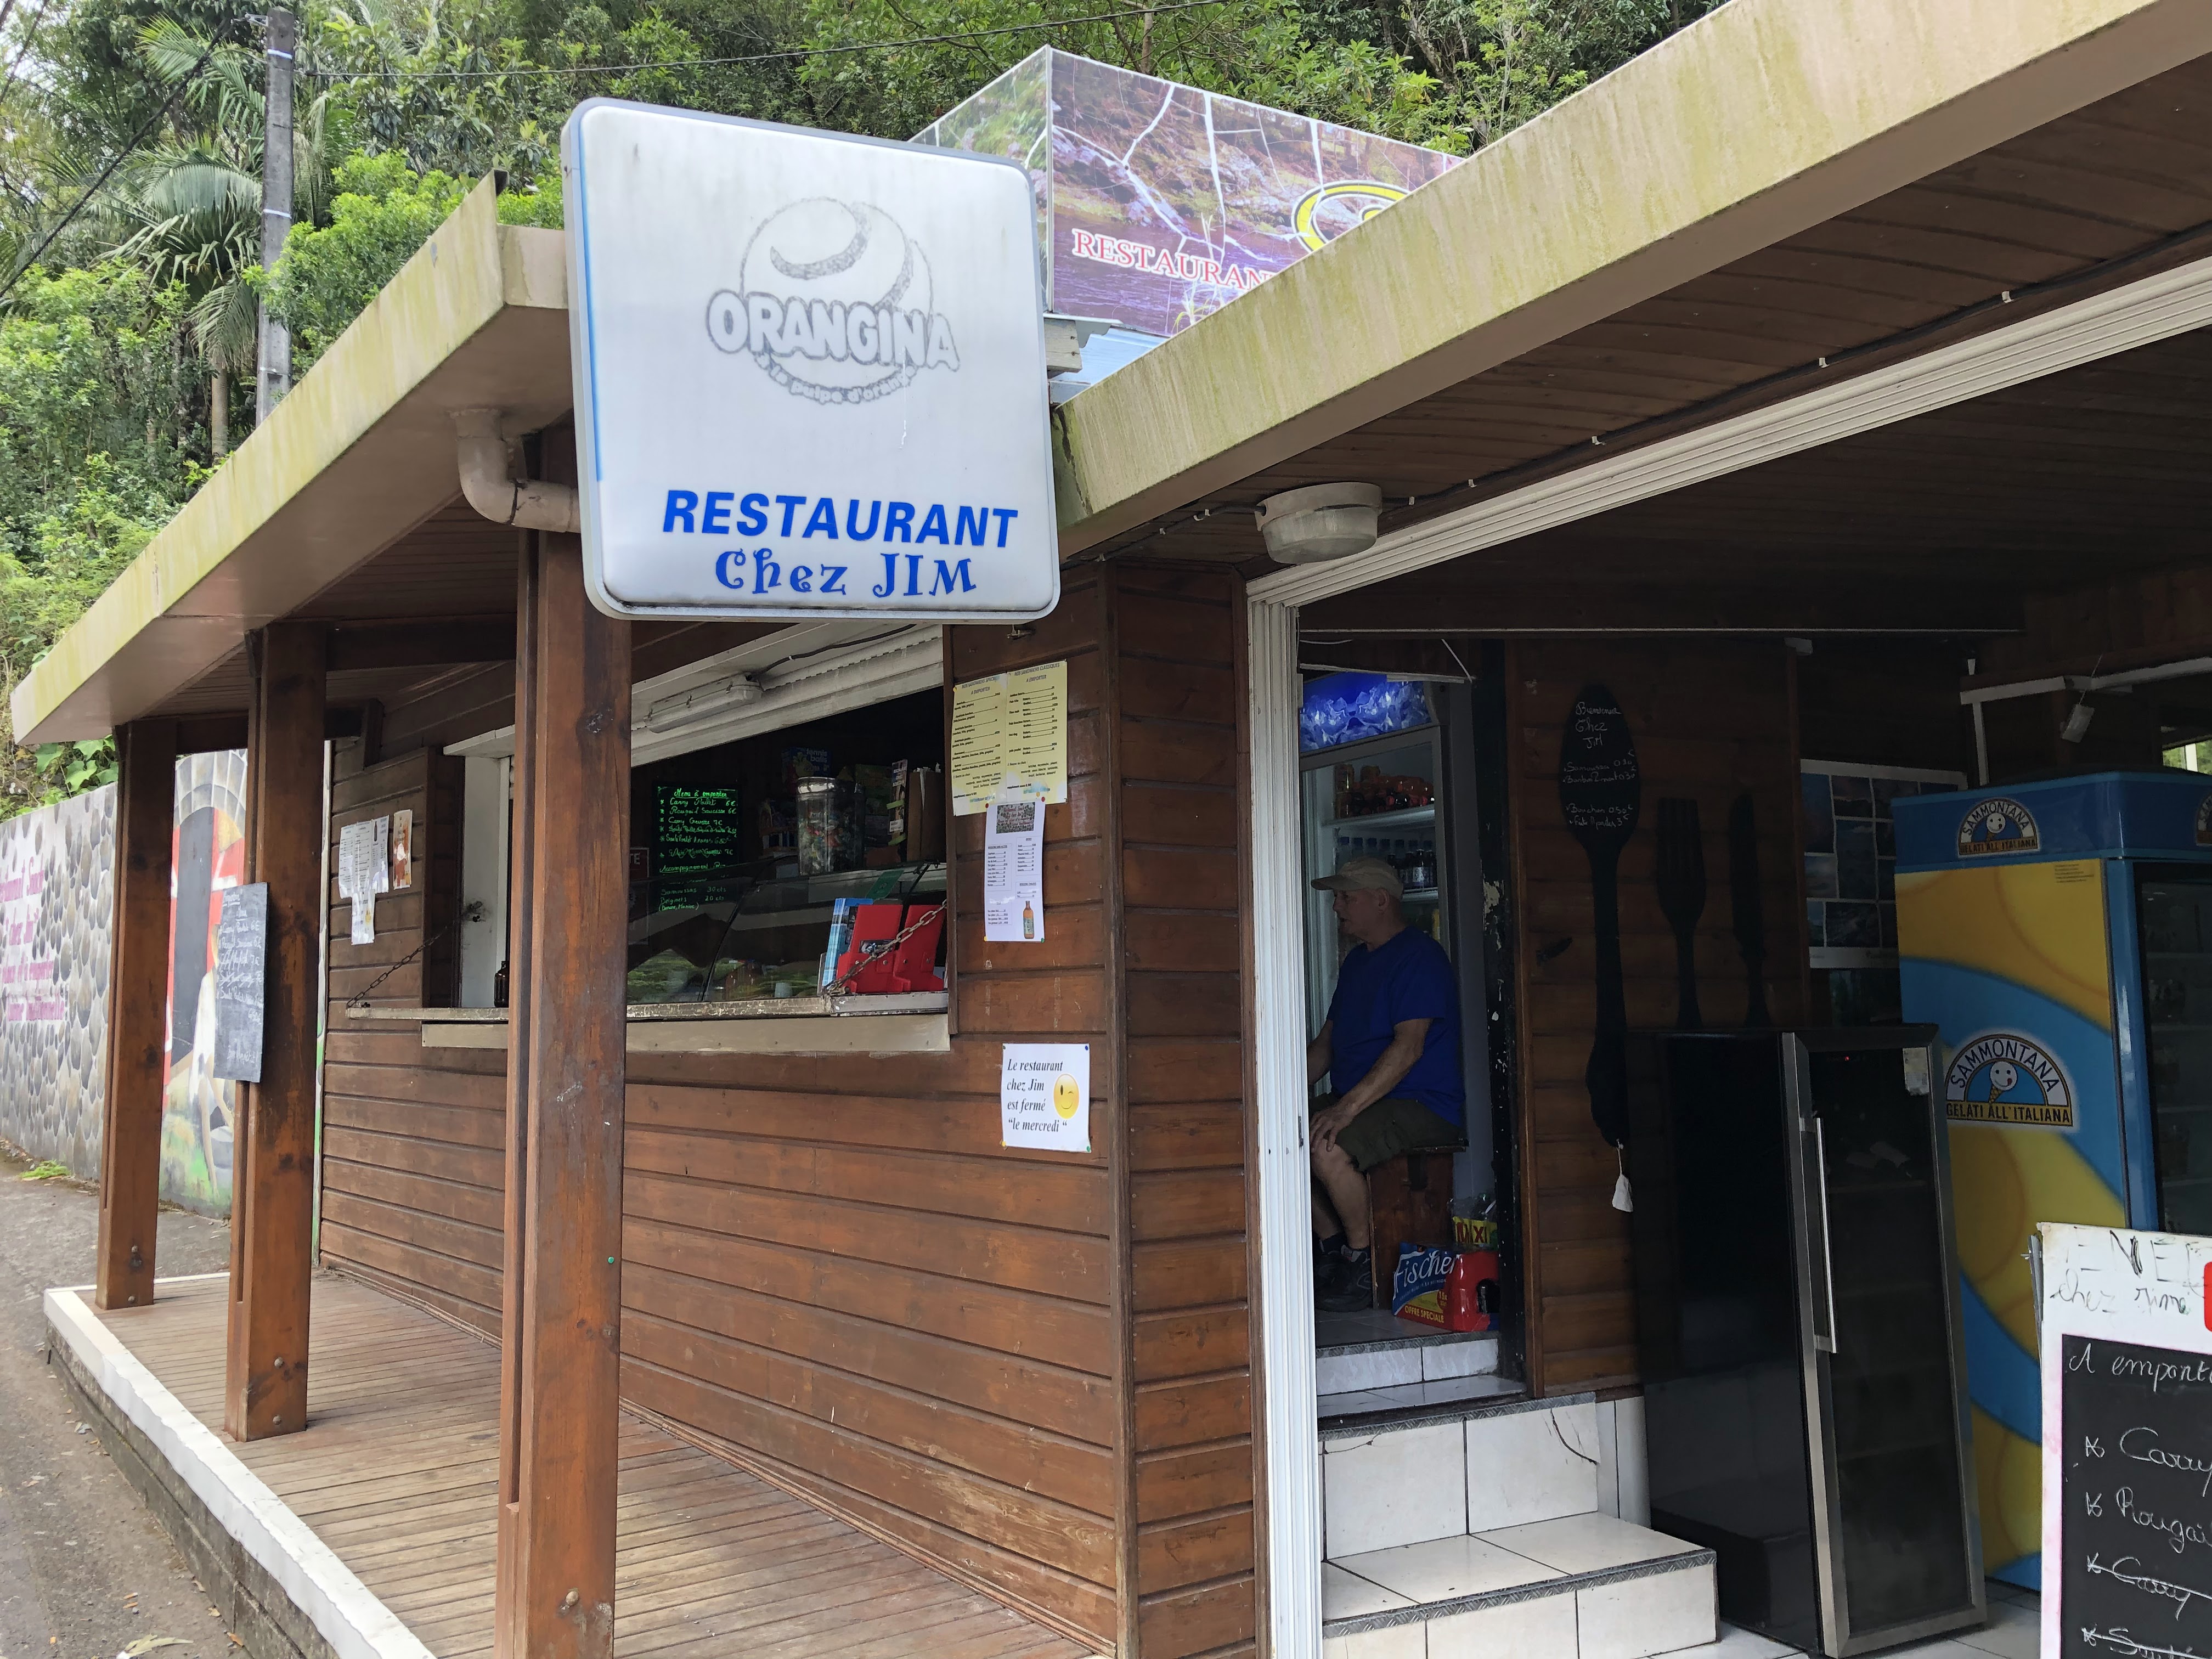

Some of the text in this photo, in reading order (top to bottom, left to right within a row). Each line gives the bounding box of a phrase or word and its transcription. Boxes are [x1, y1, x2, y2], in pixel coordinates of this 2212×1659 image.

[707, 289, 961, 372] ORANGINA
[791, 381, 842, 404] pulpe
[662, 489, 1018, 548] RESTAURANT
[715, 548, 977, 597] Chez JIM
[1962, 801, 2029, 835] SAMMONTANA
[1007, 1059, 1063, 1071] Le restaurant
[1950, 1039, 2060, 1092] SAMMONTANA
[1007, 1078, 1044, 1091] chez Jim
[1007, 1098, 1046, 1114] est fermé
[1946, 1103, 1983, 1118] GELATI
[1022, 1119, 1059, 1132] mercredi
[1392, 1249, 1460, 1300] Fischer
[1404, 1305, 1444, 1323] OFFRE SPECIALE
[2069, 1342, 2096, 1373] A
[2117, 1487, 2212, 1554] Rougai
